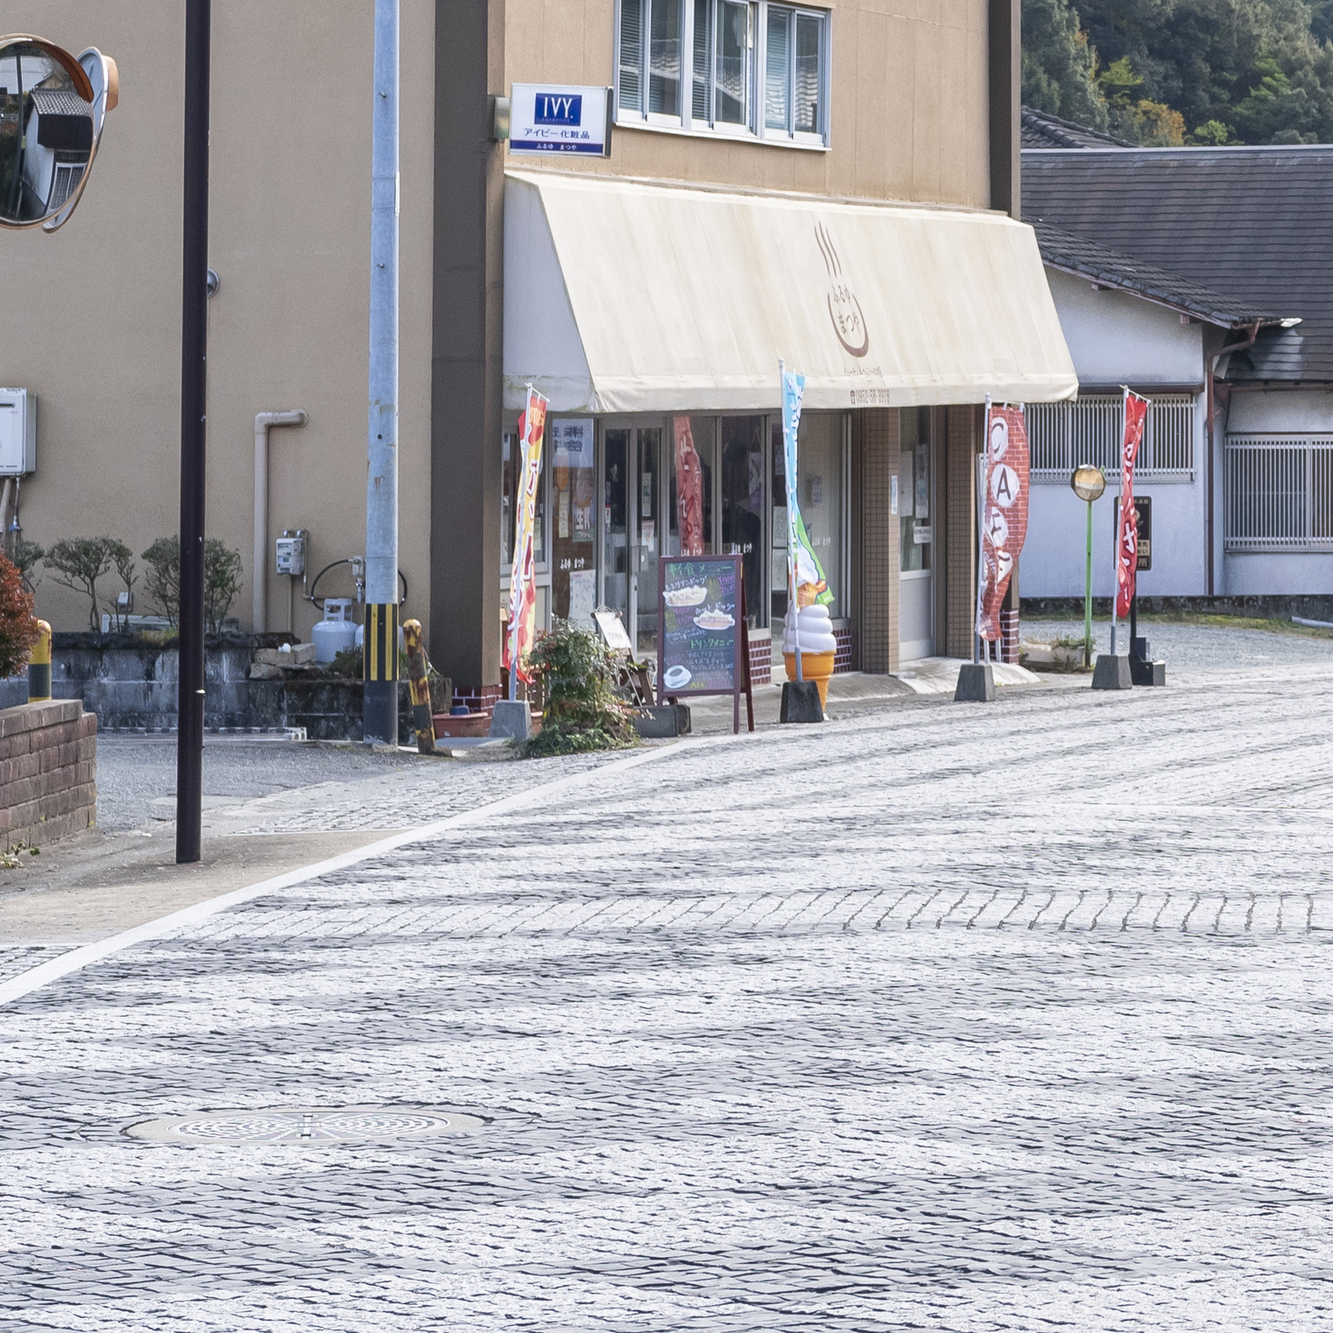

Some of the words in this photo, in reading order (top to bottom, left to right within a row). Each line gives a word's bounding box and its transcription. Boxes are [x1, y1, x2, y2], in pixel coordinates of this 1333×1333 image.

[524, 128, 590, 140] アイビー化粧品
[560, 143, 578, 151] まつや
[831, 284, 851, 304] ふるゆ
[838, 310, 861, 335] まつや
